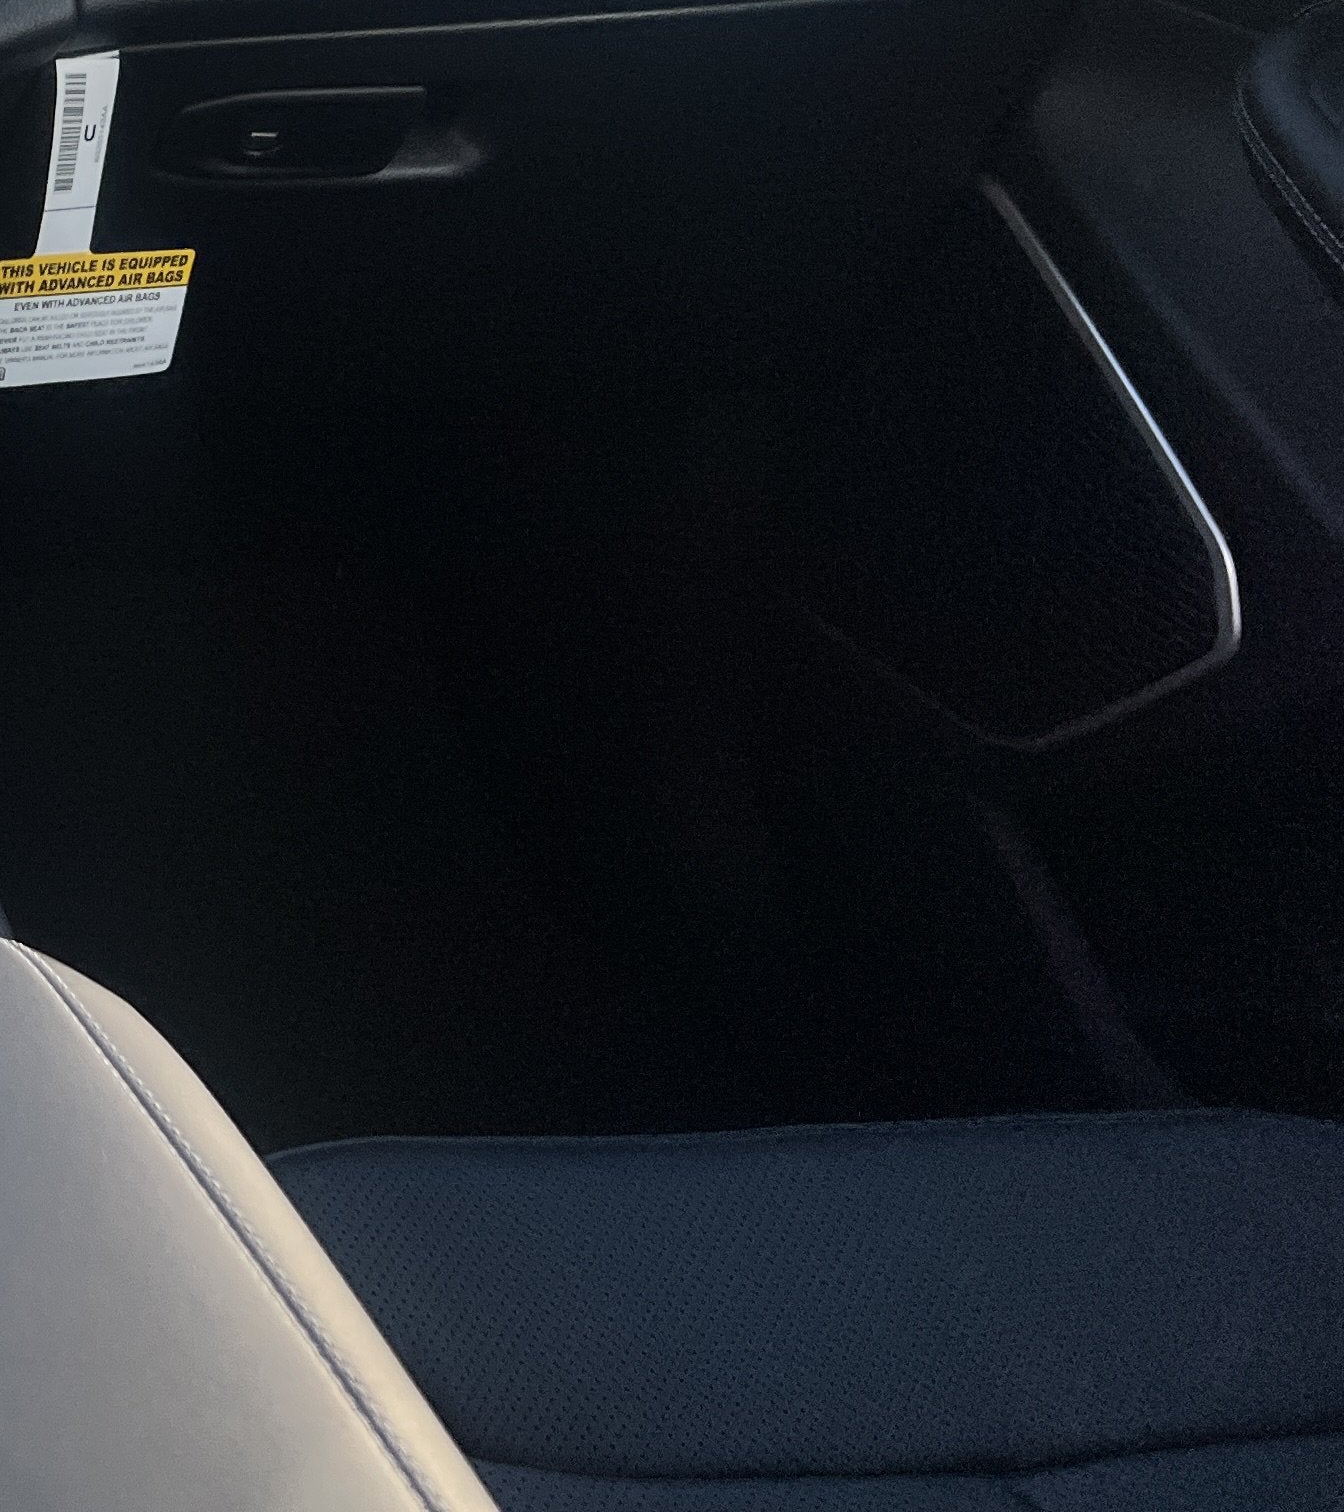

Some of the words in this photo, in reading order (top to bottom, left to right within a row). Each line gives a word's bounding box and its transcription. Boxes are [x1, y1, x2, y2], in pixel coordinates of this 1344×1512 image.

[1, 264, 33, 279] THIS
[39, 259, 98, 277] VEHICLE
[102, 258, 115, 271] IS
[119, 254, 189, 270] EQUIPPED
[38, 274, 114, 292] ADVANCED
[120, 273, 141, 286] AIR
[146, 270, 184, 284] BAGS
[14, 301, 39, 312] EVEN
[42, 299, 65, 310] WITH
[66, 295, 115, 307] ADVANCED
[117, 294, 134, 304] AIR
[135, 292, 161, 302] BAGS
